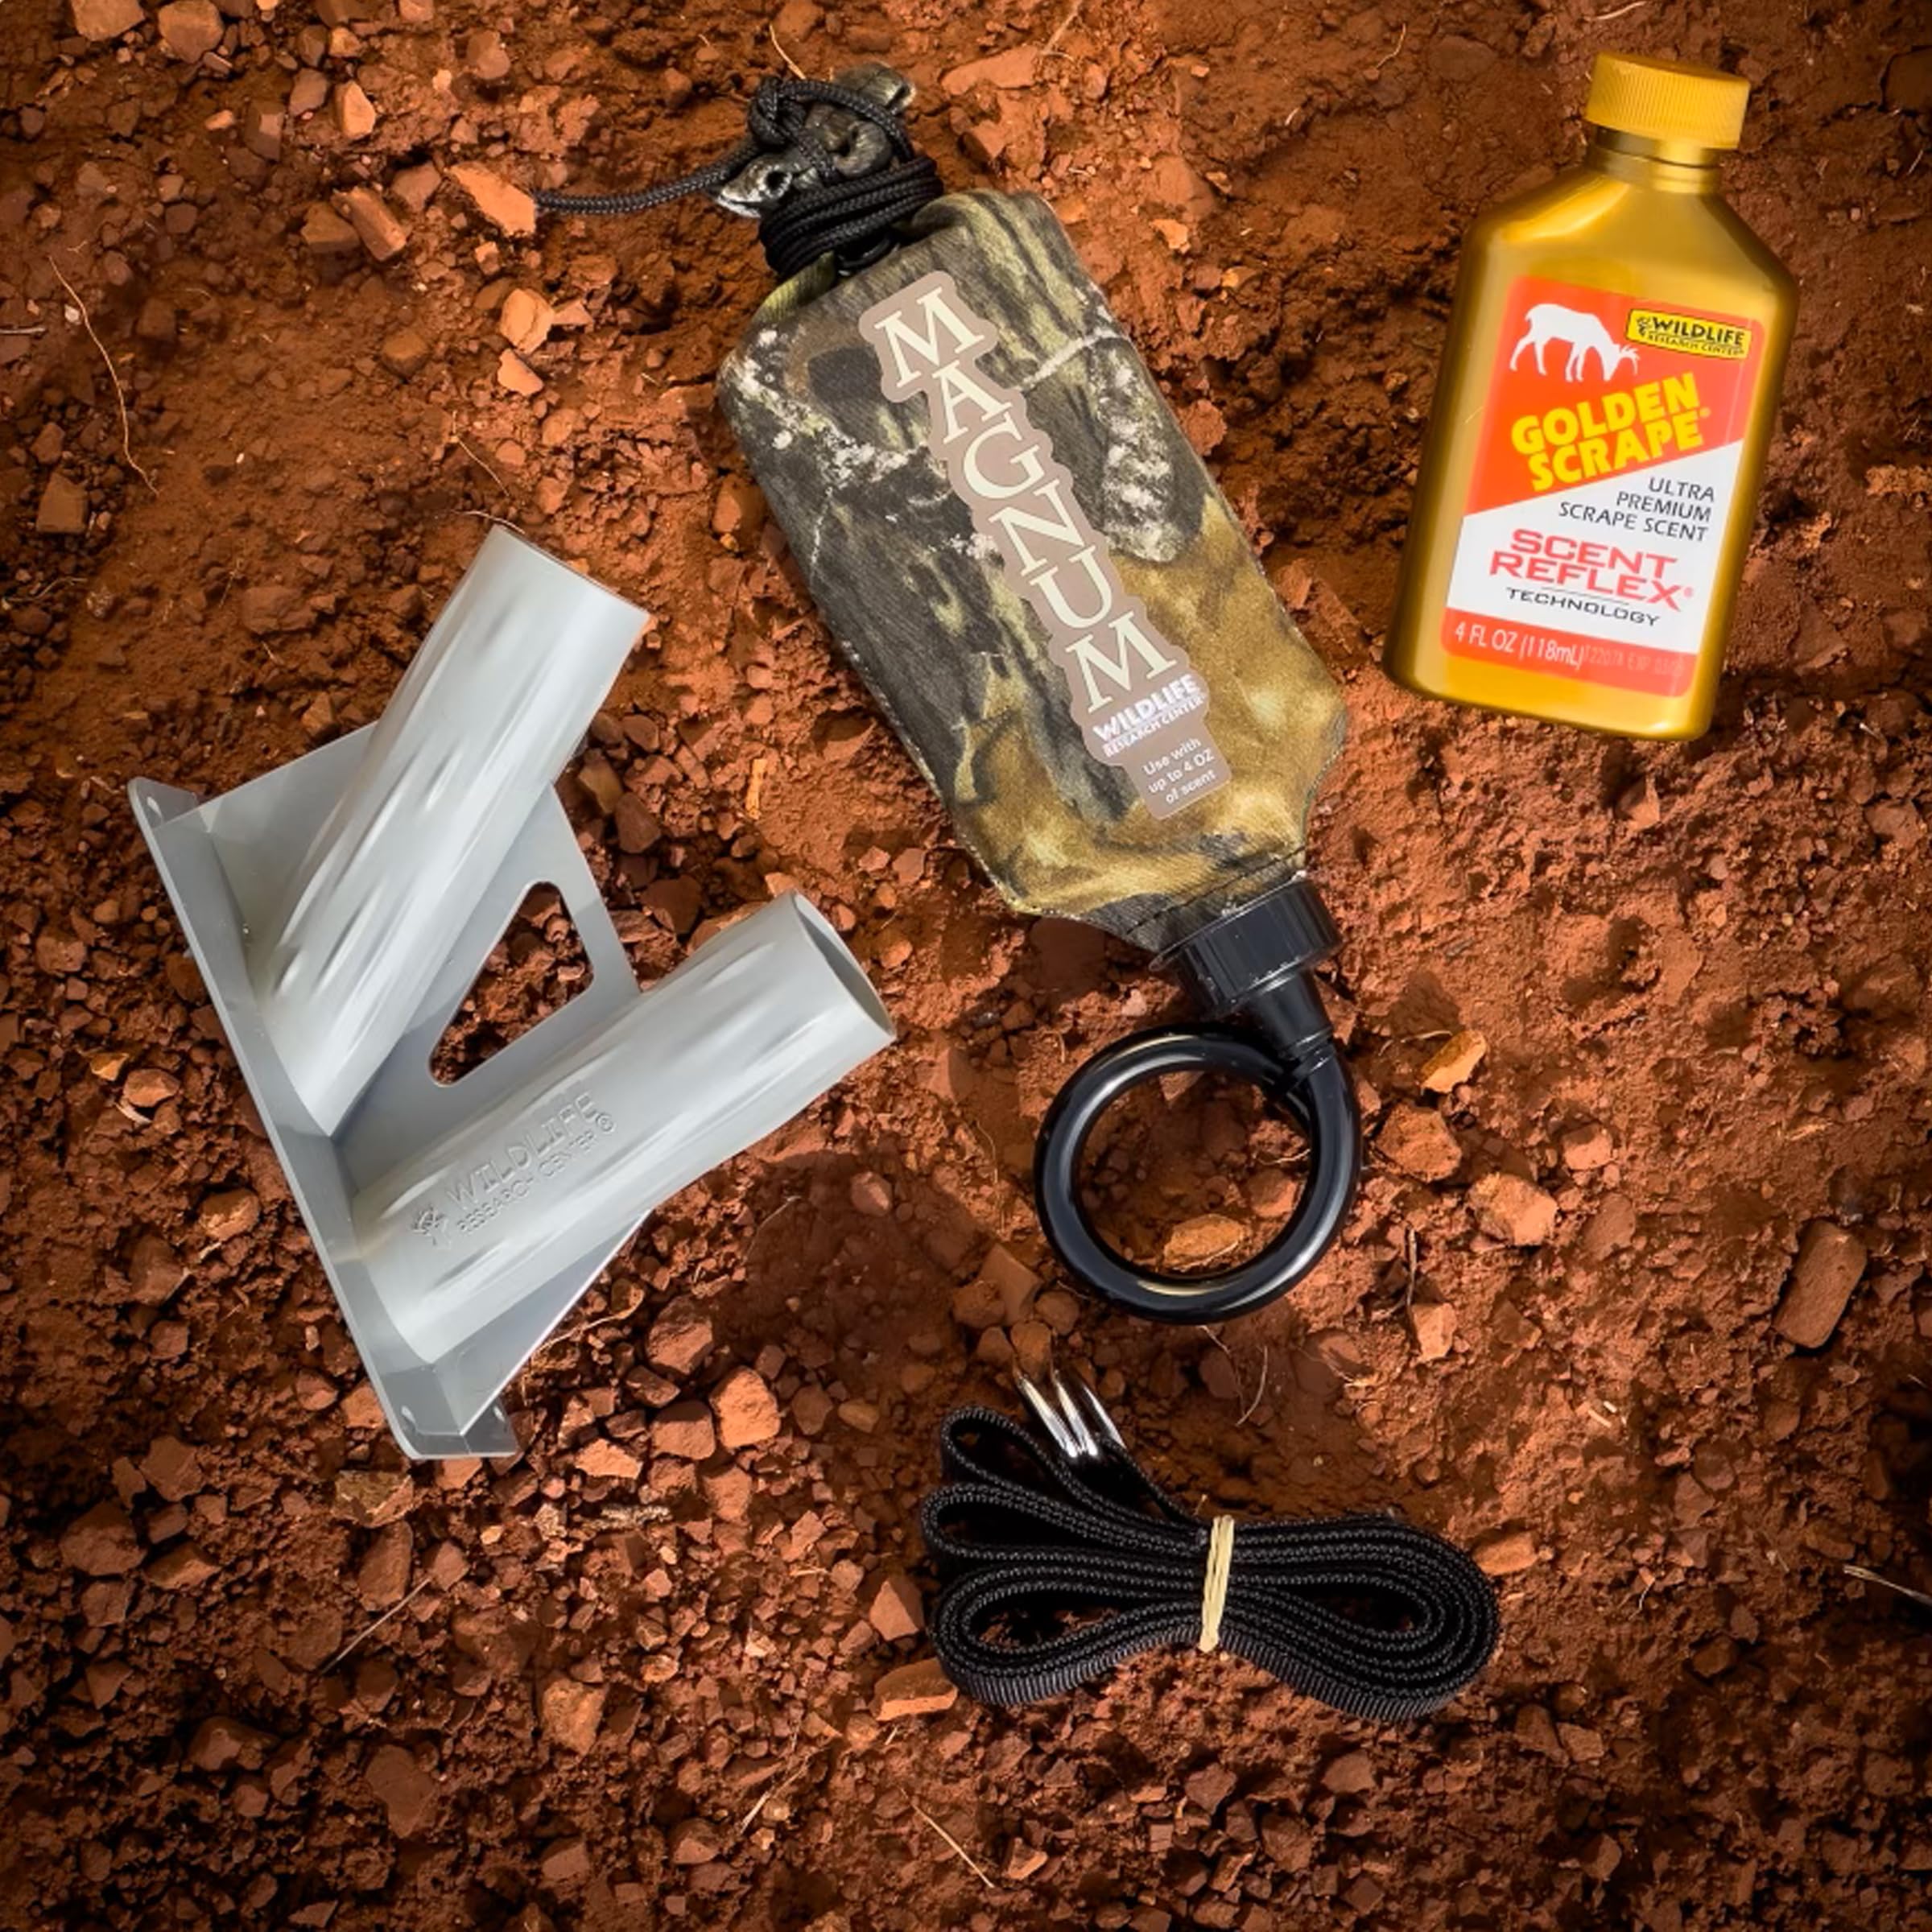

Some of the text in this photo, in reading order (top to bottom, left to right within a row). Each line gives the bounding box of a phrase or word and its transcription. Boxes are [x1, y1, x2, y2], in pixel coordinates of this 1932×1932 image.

[1653, 316, 1745, 345] WILDLIFE
[1511, 372, 1701, 456] GOLDEN
[1528, 408, 1704, 493] SCRAPE
[874, 287, 1179, 714] MAGNUM
[1616, 491, 1712, 523] PREMIUM
[1648, 477, 1715, 502] ULTRA
[1558, 501, 1709, 543] SCRAPE SCENT
[1510, 529, 1678, 580] SCENT
[1489, 551, 1686, 612] REFLEX
[1505, 587, 1661, 627] TECHNOLOGY
[1455, 621, 1586, 671] 4 FL OZ (118mL)
[1092, 674, 1202, 741] WILDLIFE
[1143, 737, 1202, 776] Use with
[1148, 778, 1167, 794] up
[1168, 767, 1183, 783] to
[1194, 748, 1215, 767] OZ
[1180, 769, 1217, 796] scent
[447, 1092, 598, 1211] WILDLIFE
